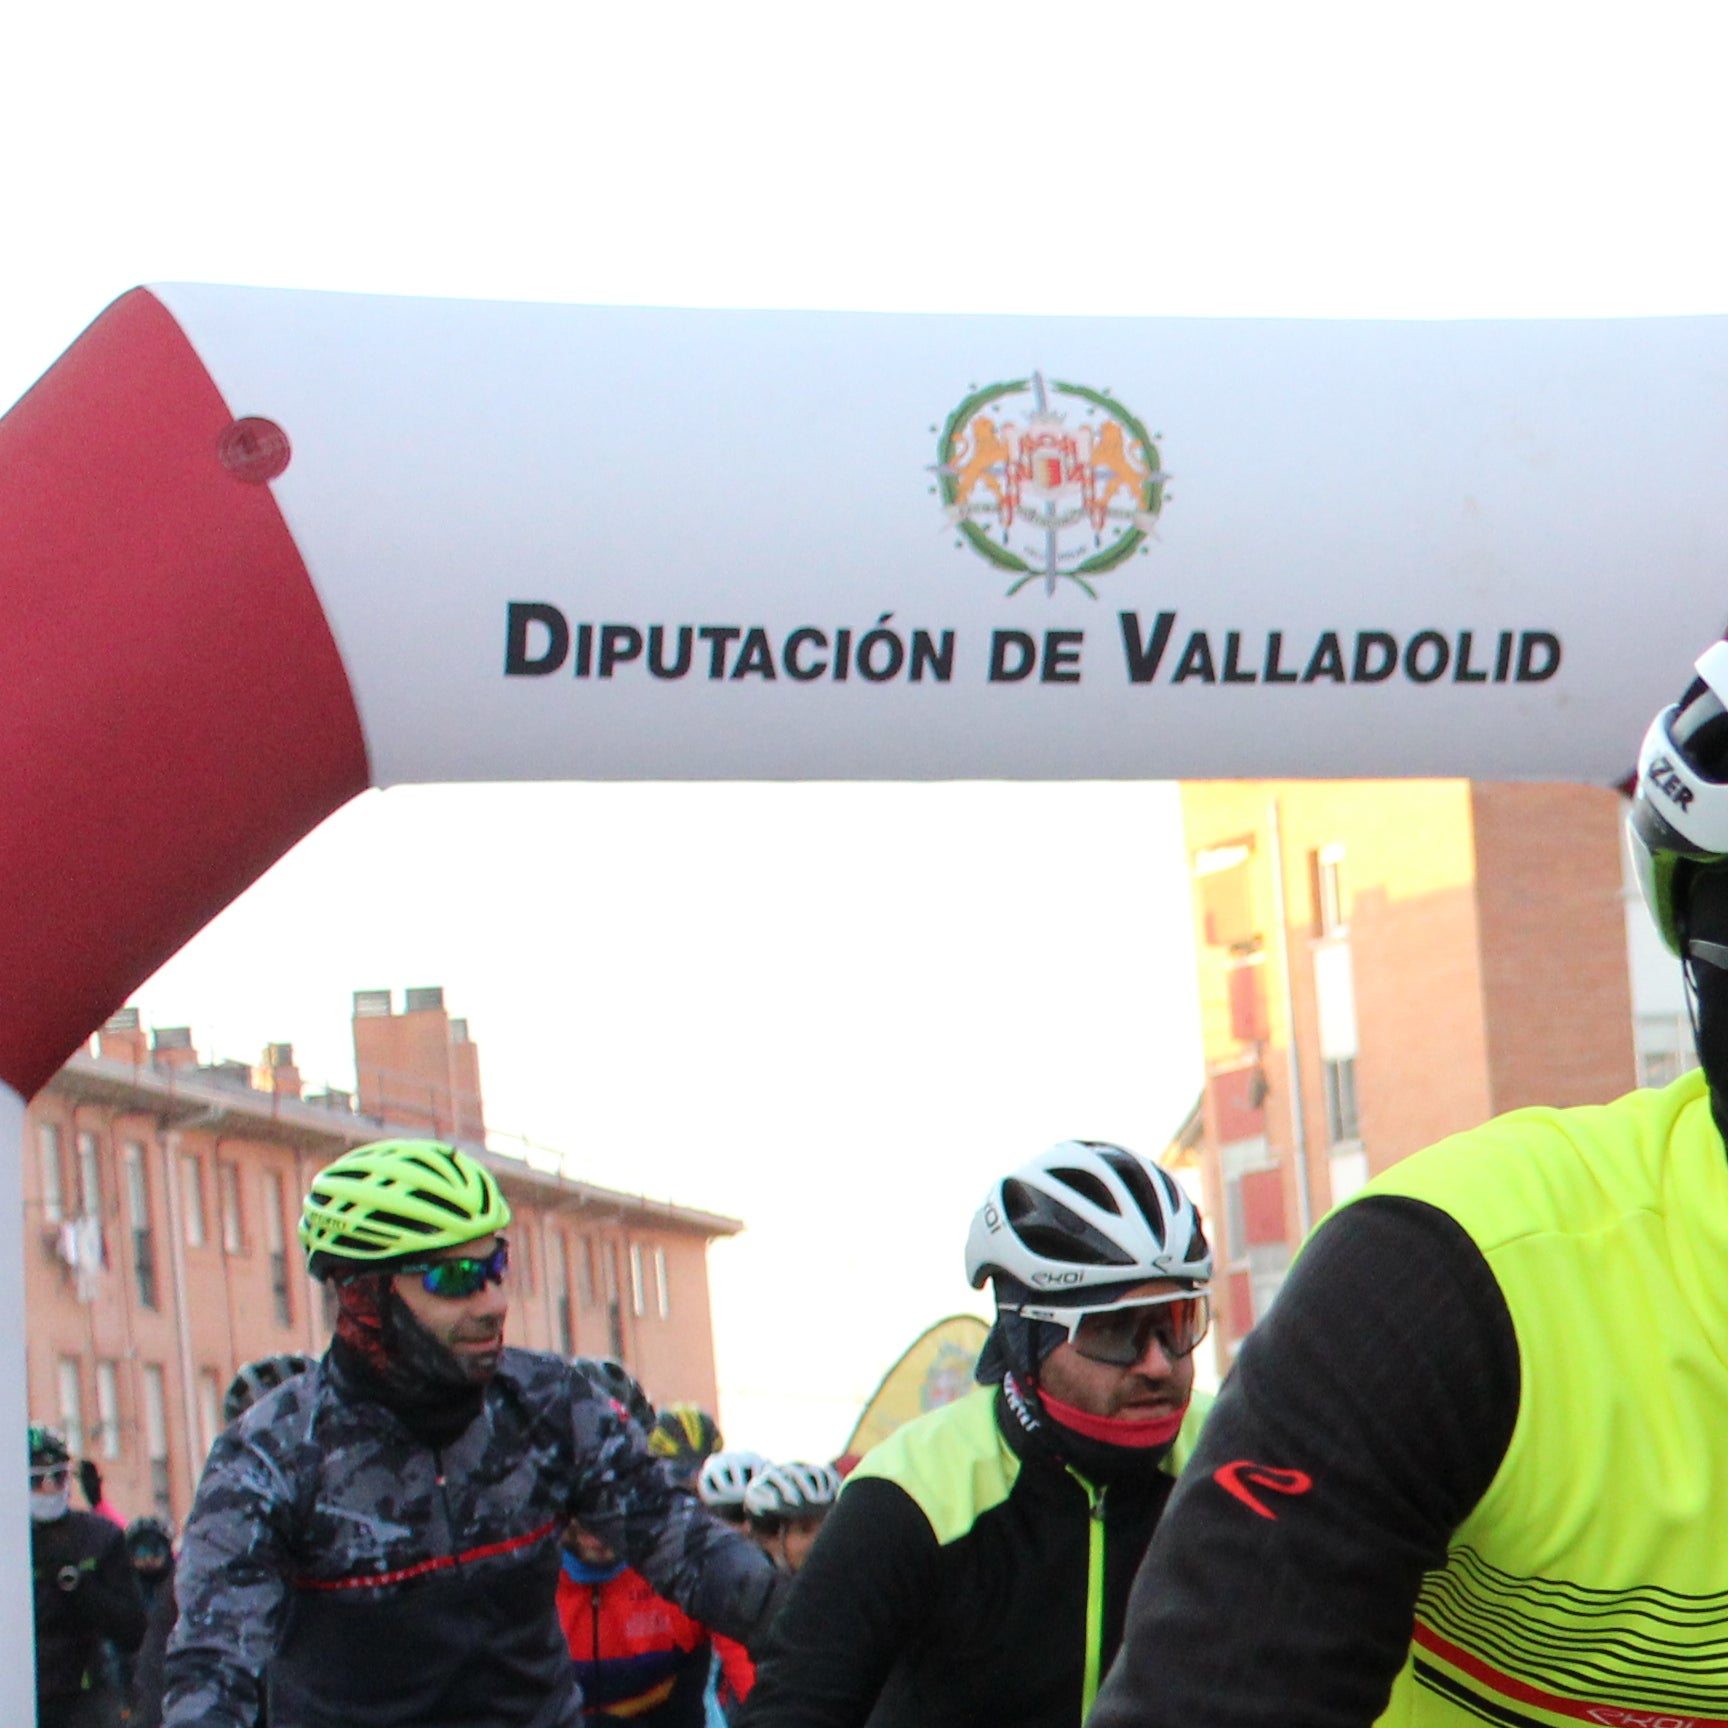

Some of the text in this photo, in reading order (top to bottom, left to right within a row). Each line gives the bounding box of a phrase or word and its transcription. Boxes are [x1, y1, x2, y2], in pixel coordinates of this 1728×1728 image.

[503, 601, 1562, 684] DIPUTACIÓN DE VALLADOLID
